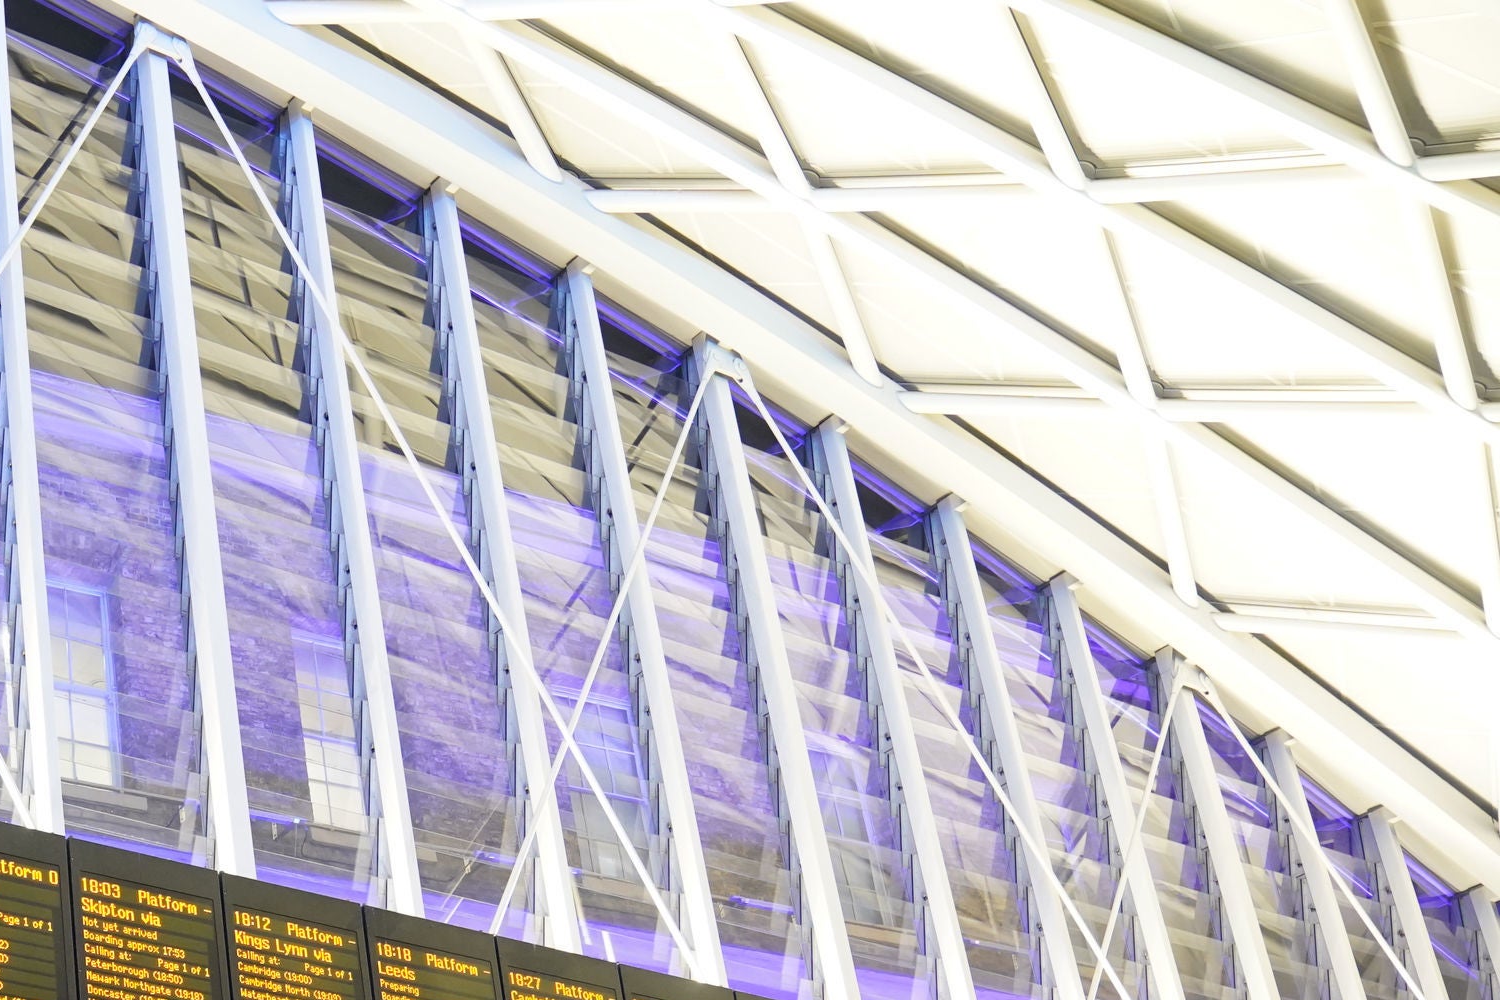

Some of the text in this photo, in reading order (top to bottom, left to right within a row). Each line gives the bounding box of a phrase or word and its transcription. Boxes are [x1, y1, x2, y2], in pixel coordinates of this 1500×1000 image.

[48, 869, 58, 885] 0
[80, 896, 162, 927] Skipton via
[81, 877, 198, 916] 18:03 Platform
[82, 915, 158, 941] Not yet arrived
[234, 911, 343, 947] 18:12 Platform
[234, 929, 333, 963] Kings Lynn via
[376, 942, 478, 977] 18:18 Platform
[377, 960, 416, 981] Leeds
[508, 971, 541, 990] 18:27
